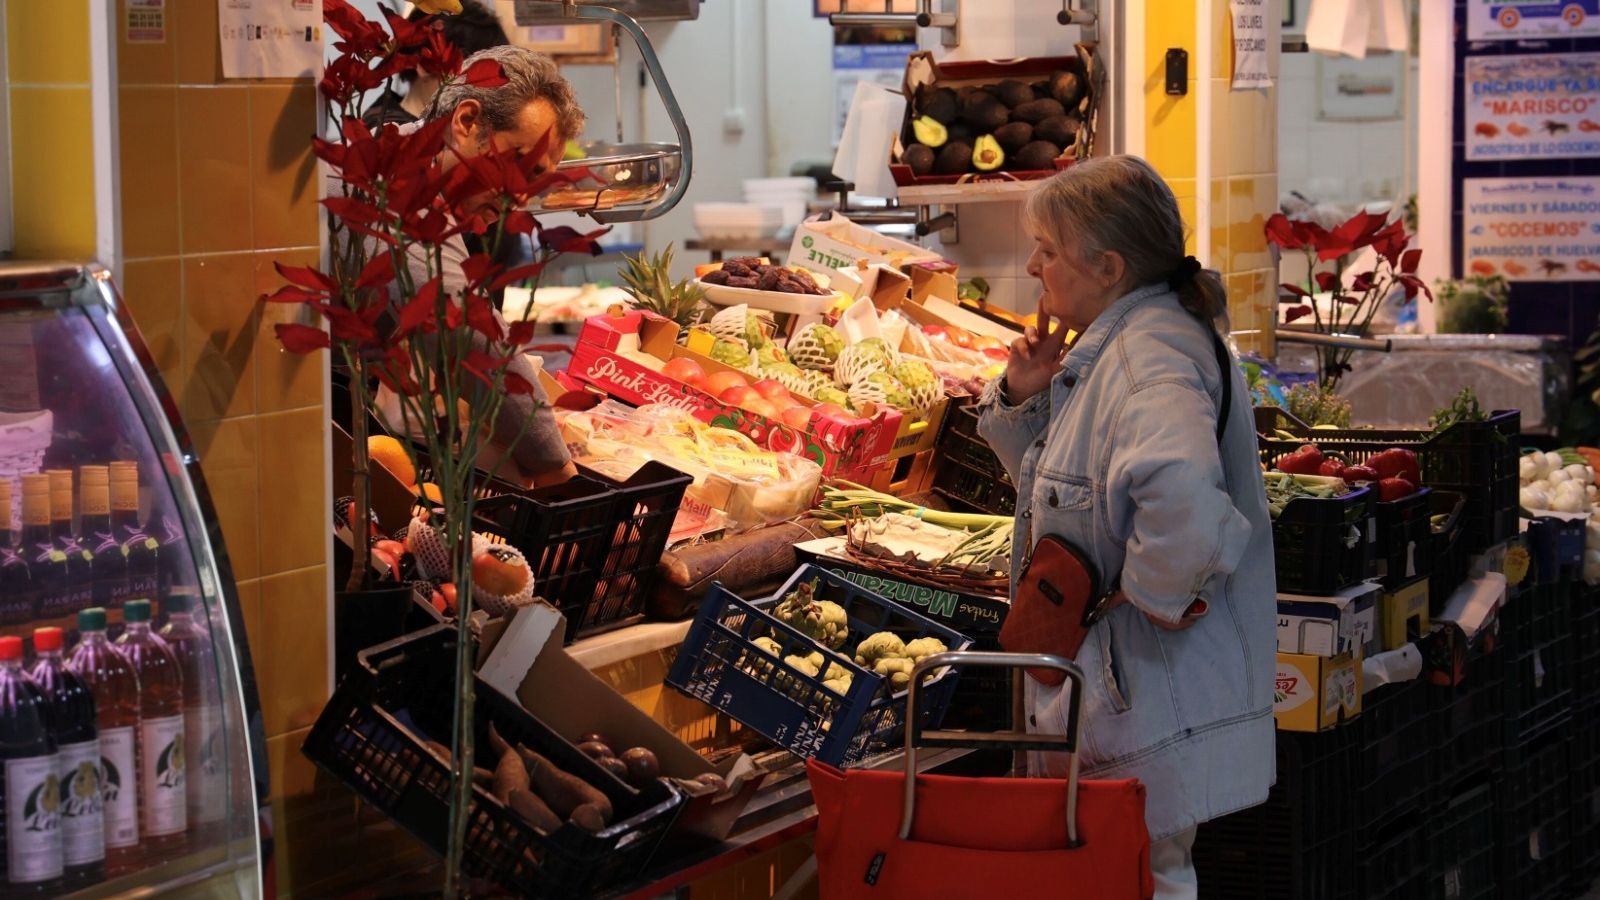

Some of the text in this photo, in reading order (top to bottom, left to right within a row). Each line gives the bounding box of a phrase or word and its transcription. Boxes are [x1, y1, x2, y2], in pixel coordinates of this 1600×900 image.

[1470, 203, 1528, 214] VIERNES
[1531, 203, 1539, 213] Y
[1537, 245, 1551, 256] DE
[587, 356, 699, 417] Pink Lady
[959, 604, 1000, 624] Frutas
